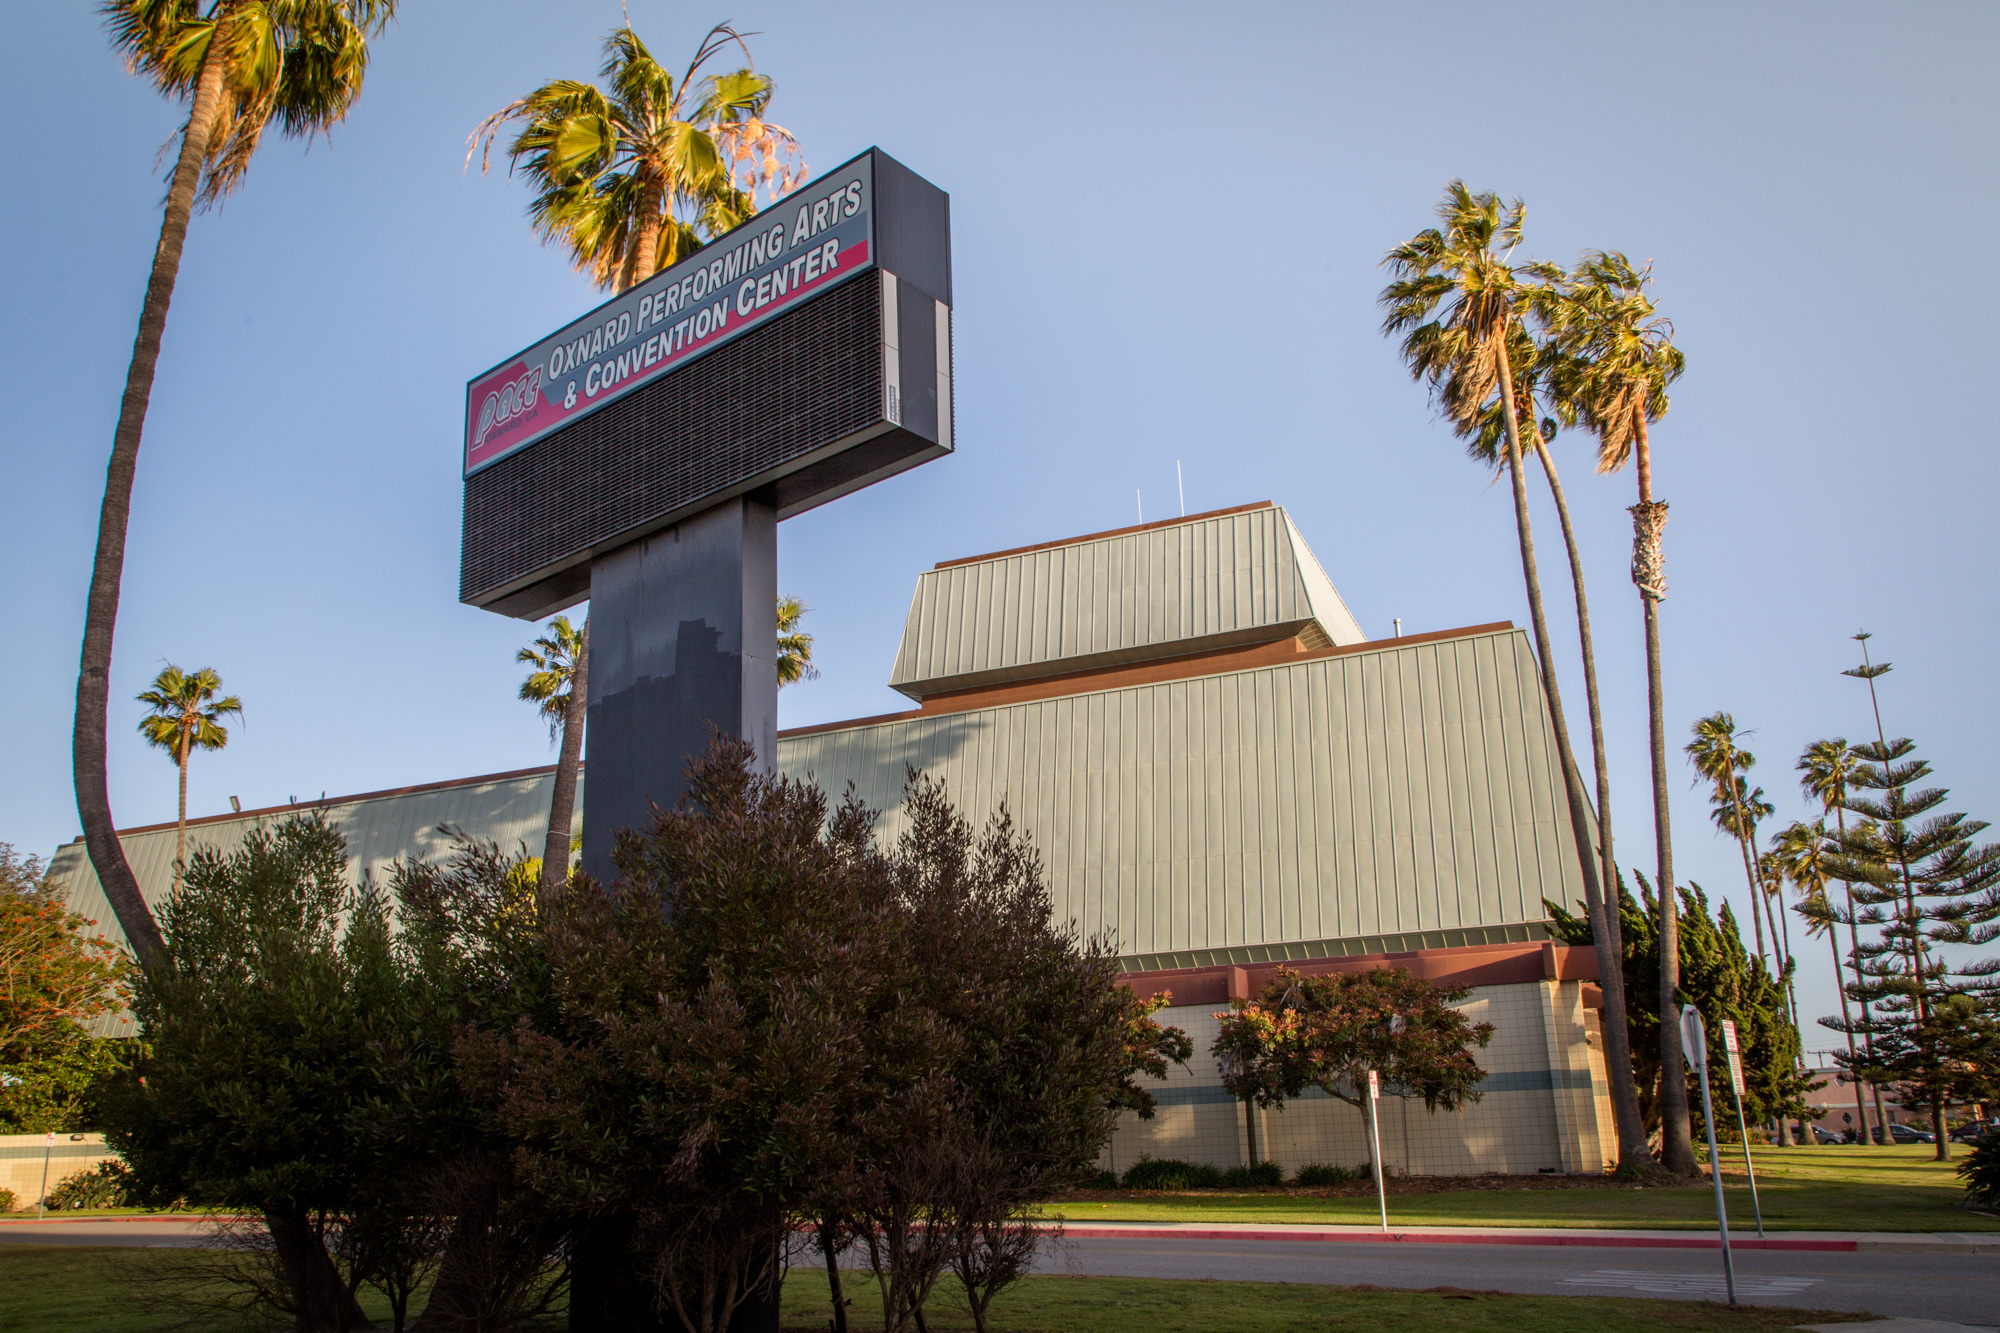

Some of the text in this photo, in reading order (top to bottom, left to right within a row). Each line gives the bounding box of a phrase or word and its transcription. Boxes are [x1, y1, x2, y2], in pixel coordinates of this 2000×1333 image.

[548, 179, 862, 381] OXNARD PERFORMING ARTS
[563, 237, 840, 410] & CONVENTION CENTER
[525, 408, 538, 422] CA
